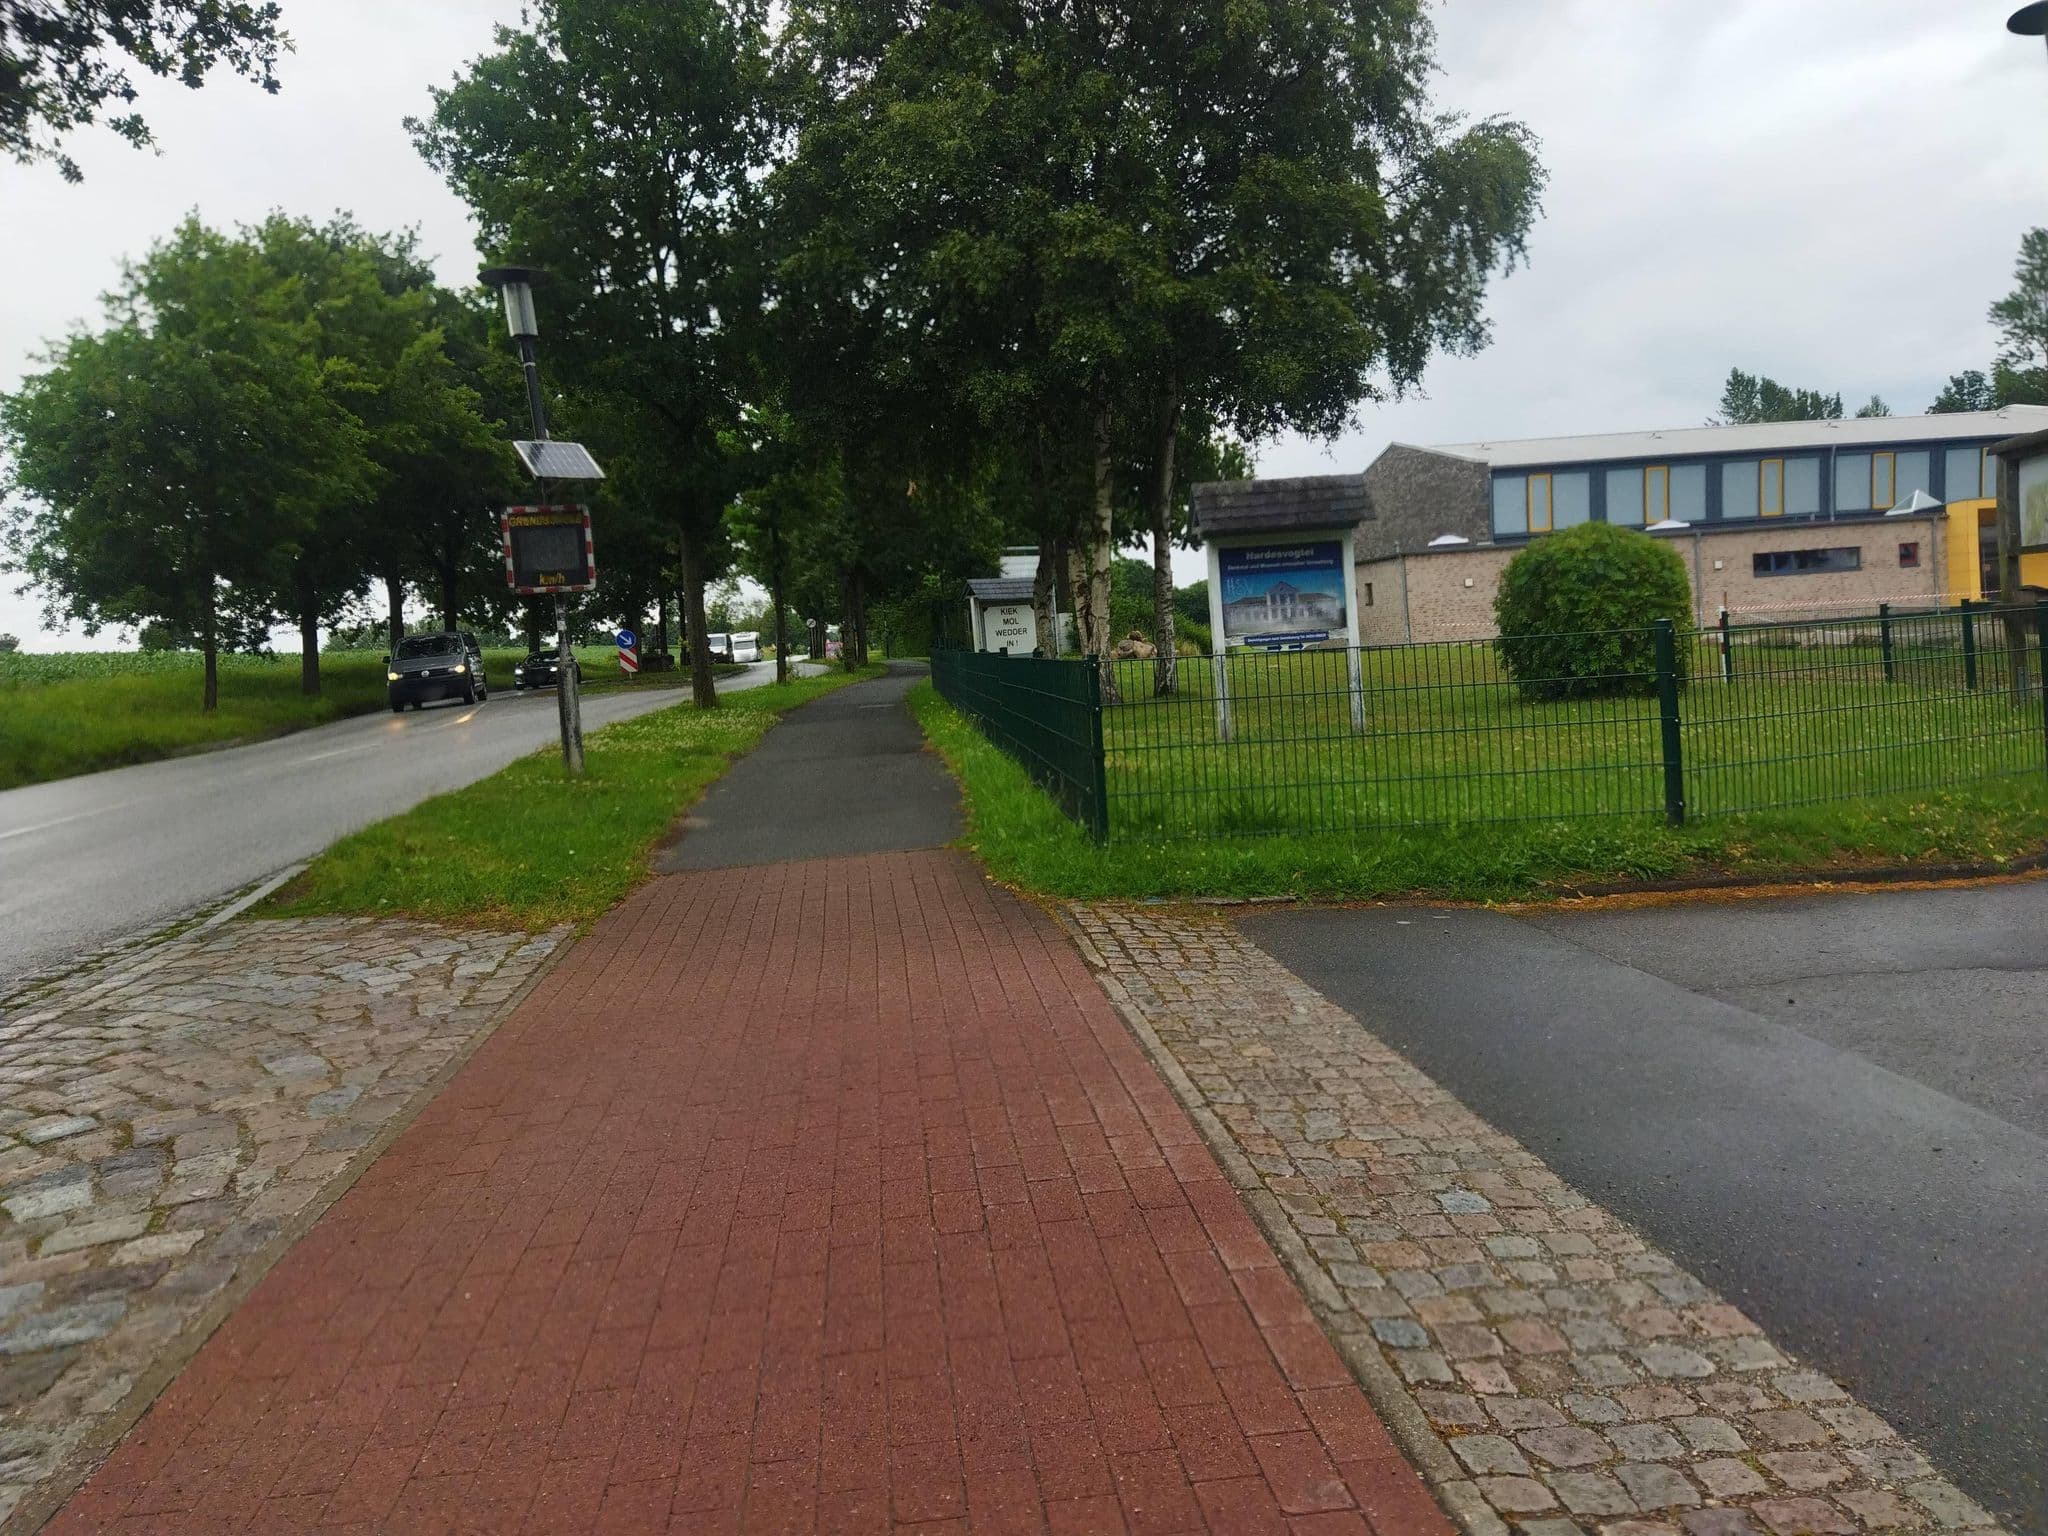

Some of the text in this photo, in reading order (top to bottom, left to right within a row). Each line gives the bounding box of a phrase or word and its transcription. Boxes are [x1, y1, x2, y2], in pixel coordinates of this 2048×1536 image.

[539, 571, 565, 585] km/h
[1000, 607, 1018, 616] KIEK
[1003, 617, 1019, 625] MOL
[995, 627, 1028, 637] WEDDER
